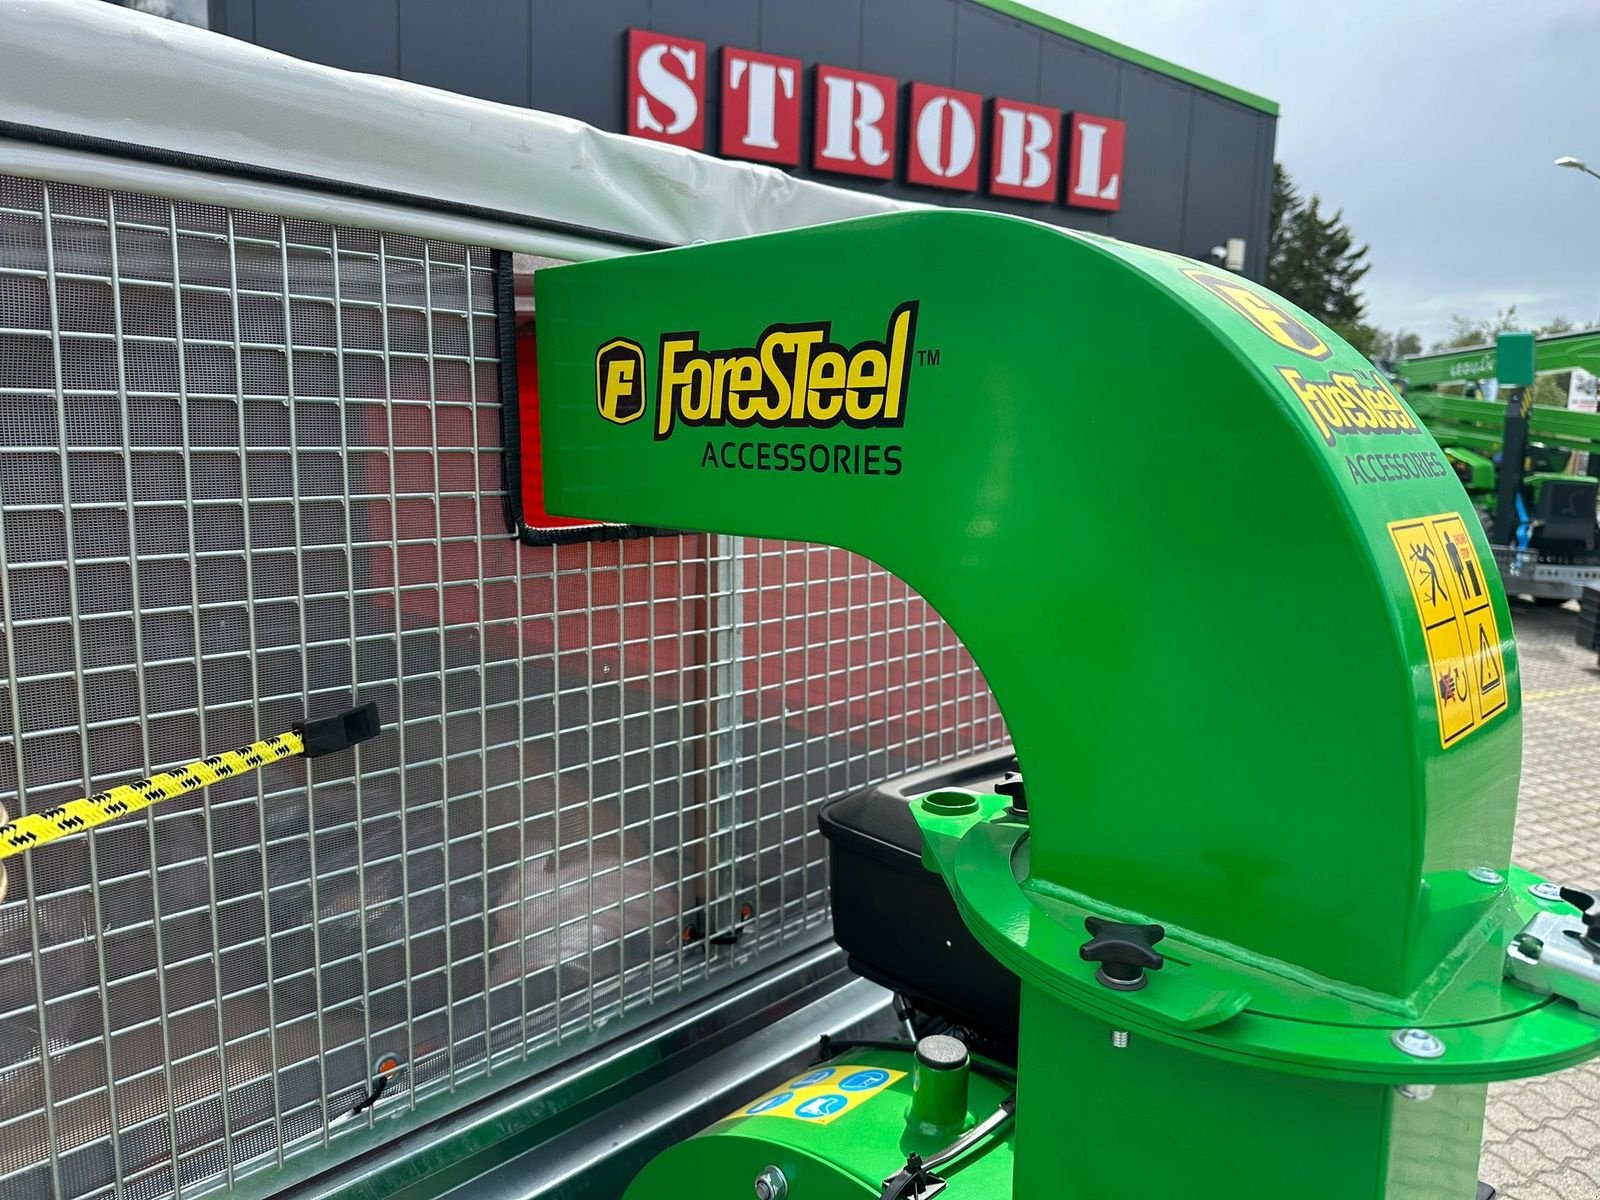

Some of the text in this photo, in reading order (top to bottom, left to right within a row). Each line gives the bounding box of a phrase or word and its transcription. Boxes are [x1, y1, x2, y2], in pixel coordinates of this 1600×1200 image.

[636, 43, 1120, 200] STROBL
[701, 440, 904, 476] ACCESSORIES
[1344, 451, 1447, 485] ACCESSORIES
